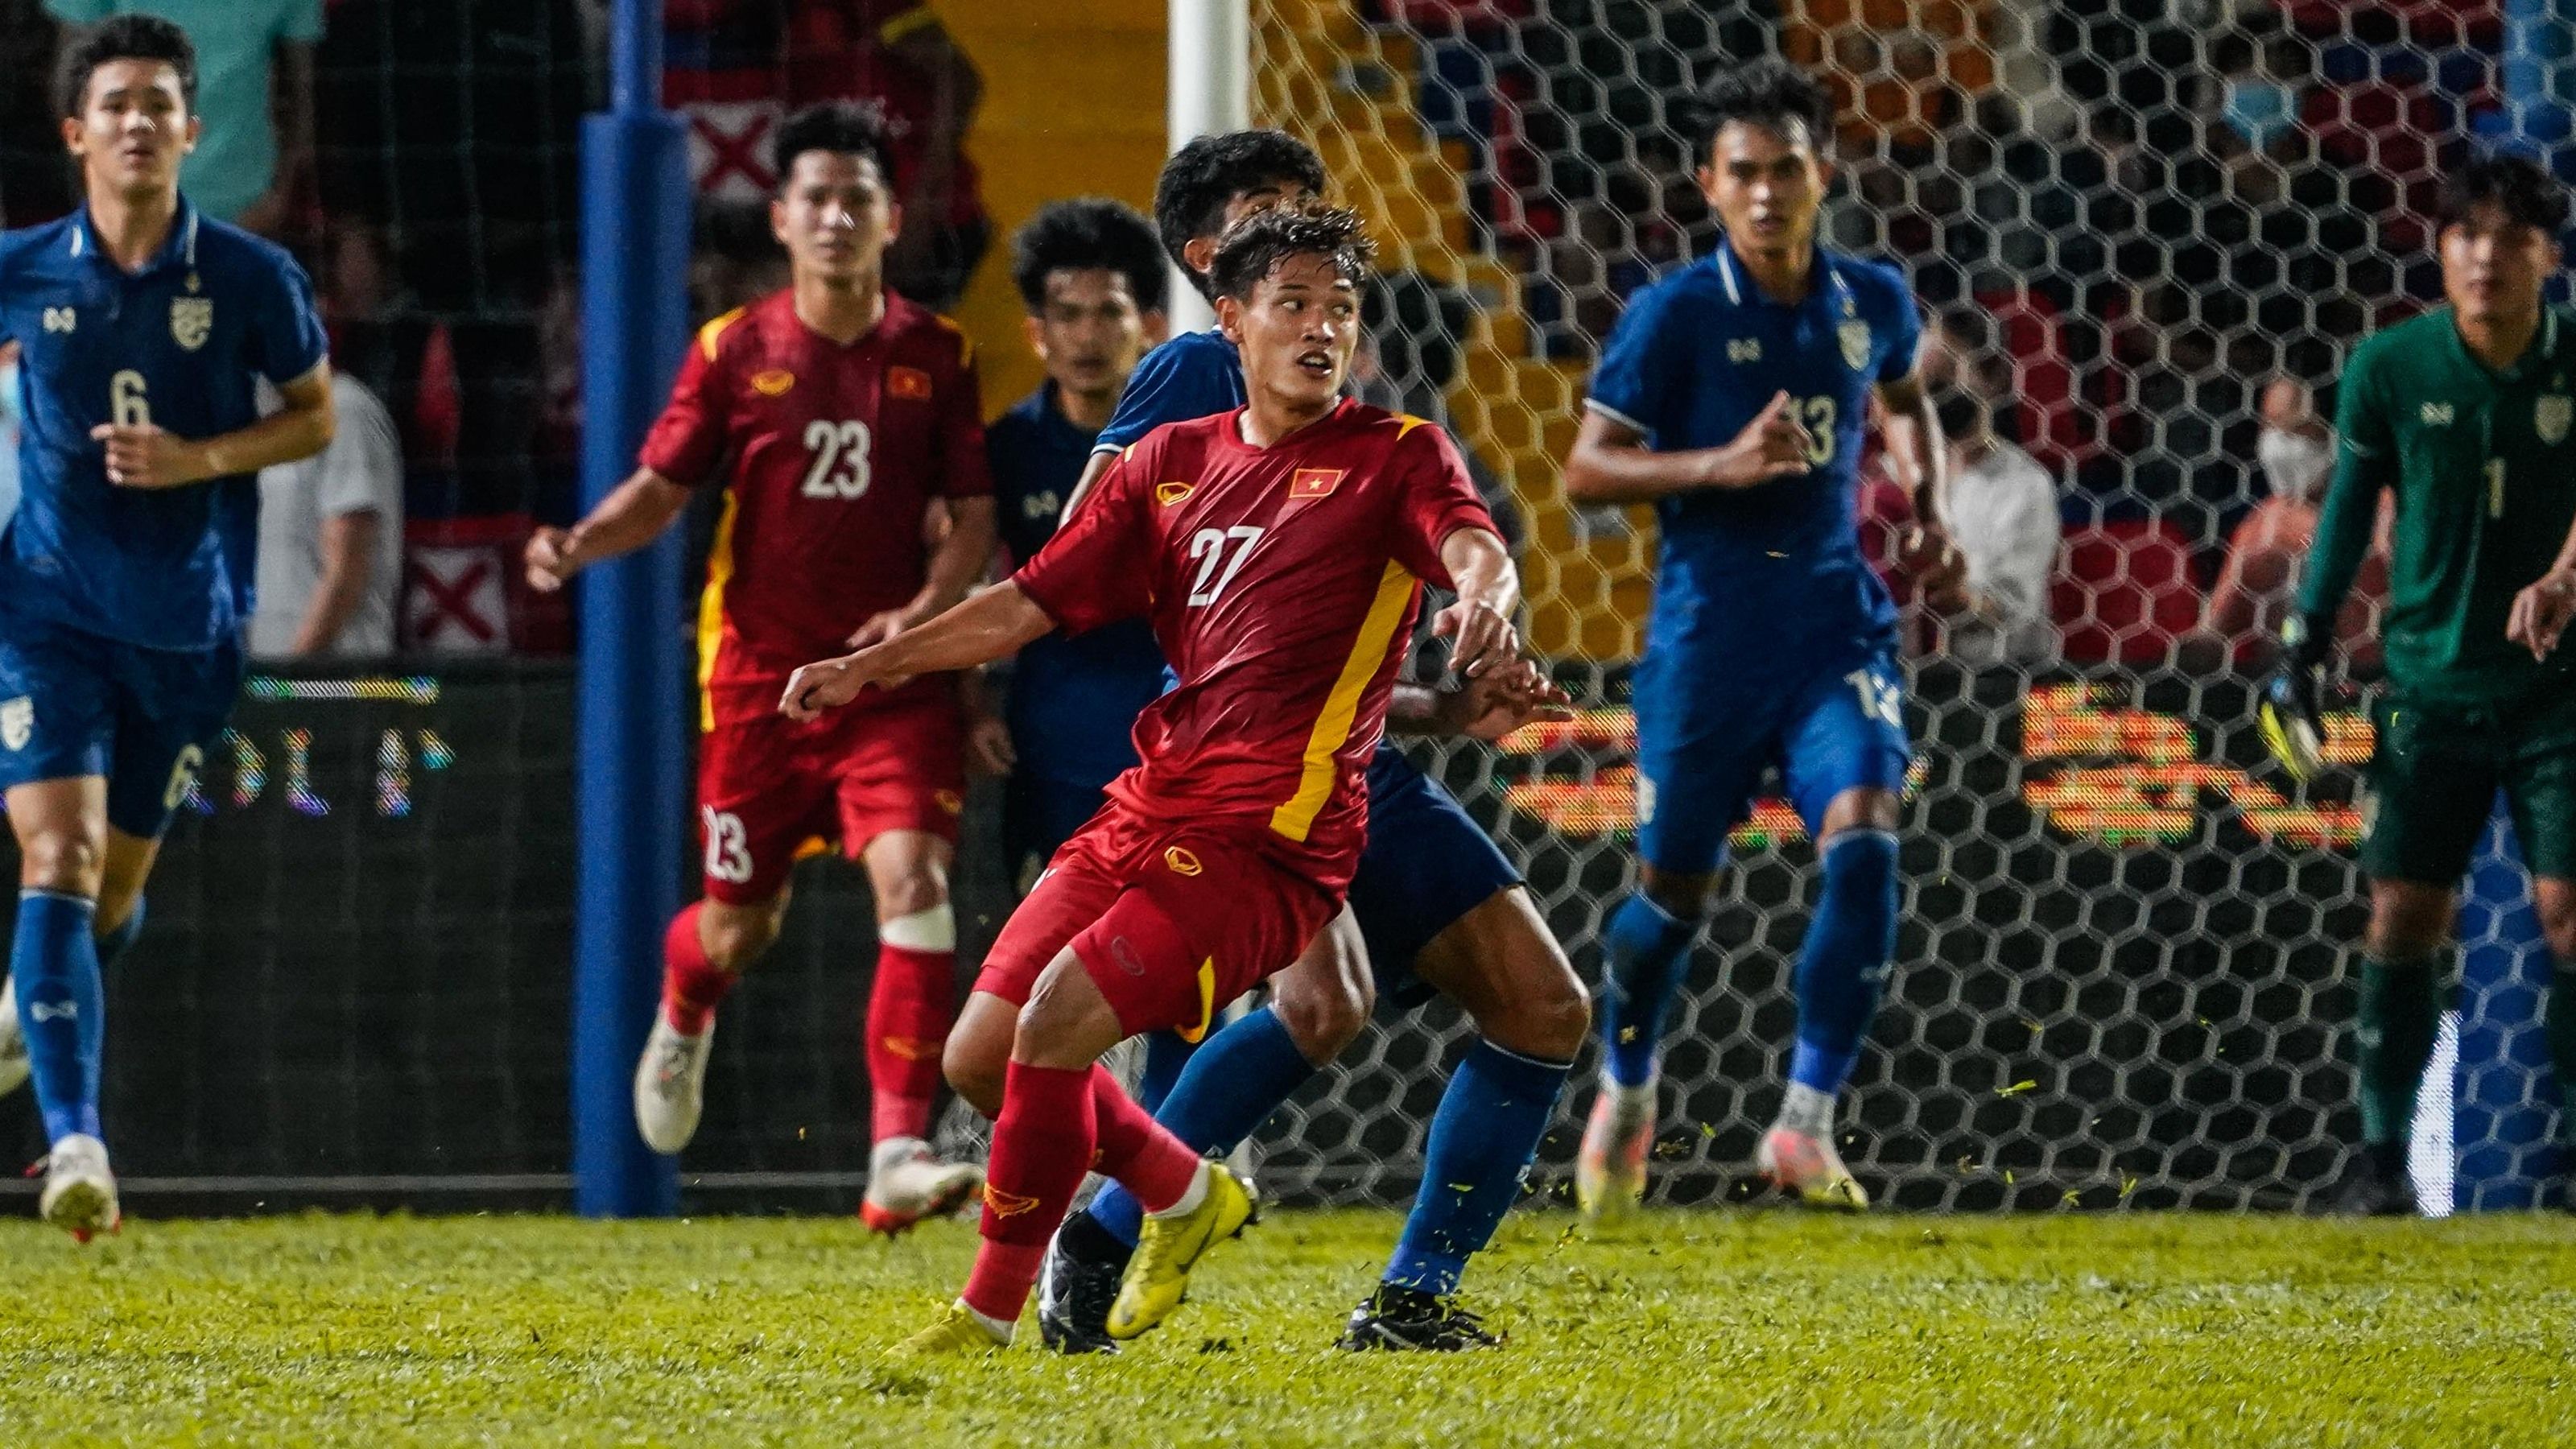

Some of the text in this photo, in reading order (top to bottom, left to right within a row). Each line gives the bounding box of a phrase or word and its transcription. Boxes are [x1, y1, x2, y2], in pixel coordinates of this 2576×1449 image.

[800, 419, 871, 499] 23
[2482, 458, 2506, 518] 1
[1187, 526, 1266, 606] 27
